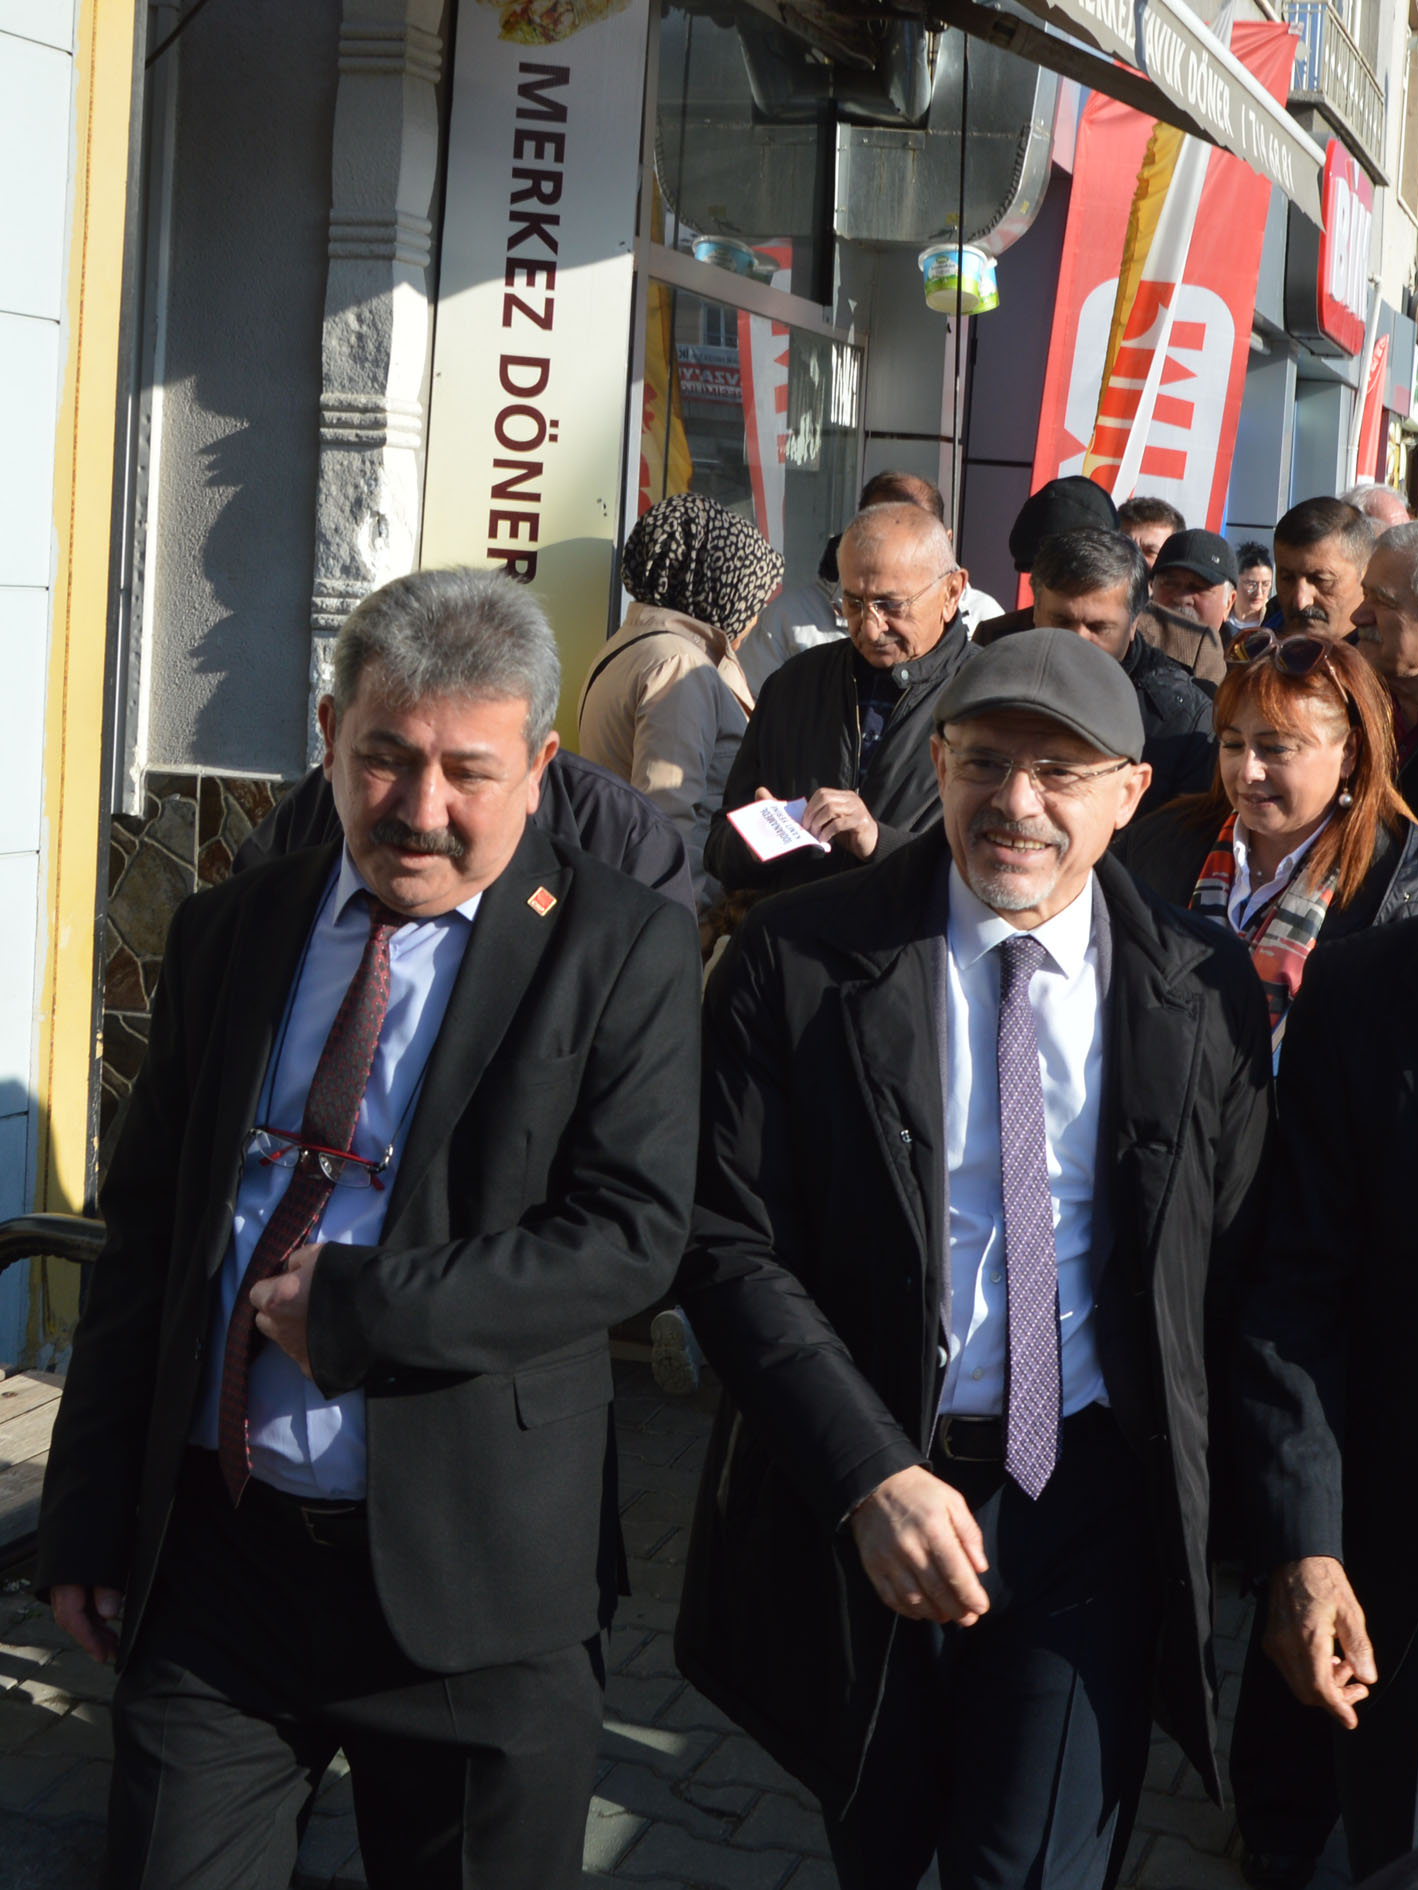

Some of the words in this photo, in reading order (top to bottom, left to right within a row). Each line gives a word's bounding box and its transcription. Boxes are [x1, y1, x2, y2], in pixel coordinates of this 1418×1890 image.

[501, 61, 571, 331] MERKEZ
[1188, 48, 1233, 138] DÖNER
[486, 353, 560, 585] DÖNER
